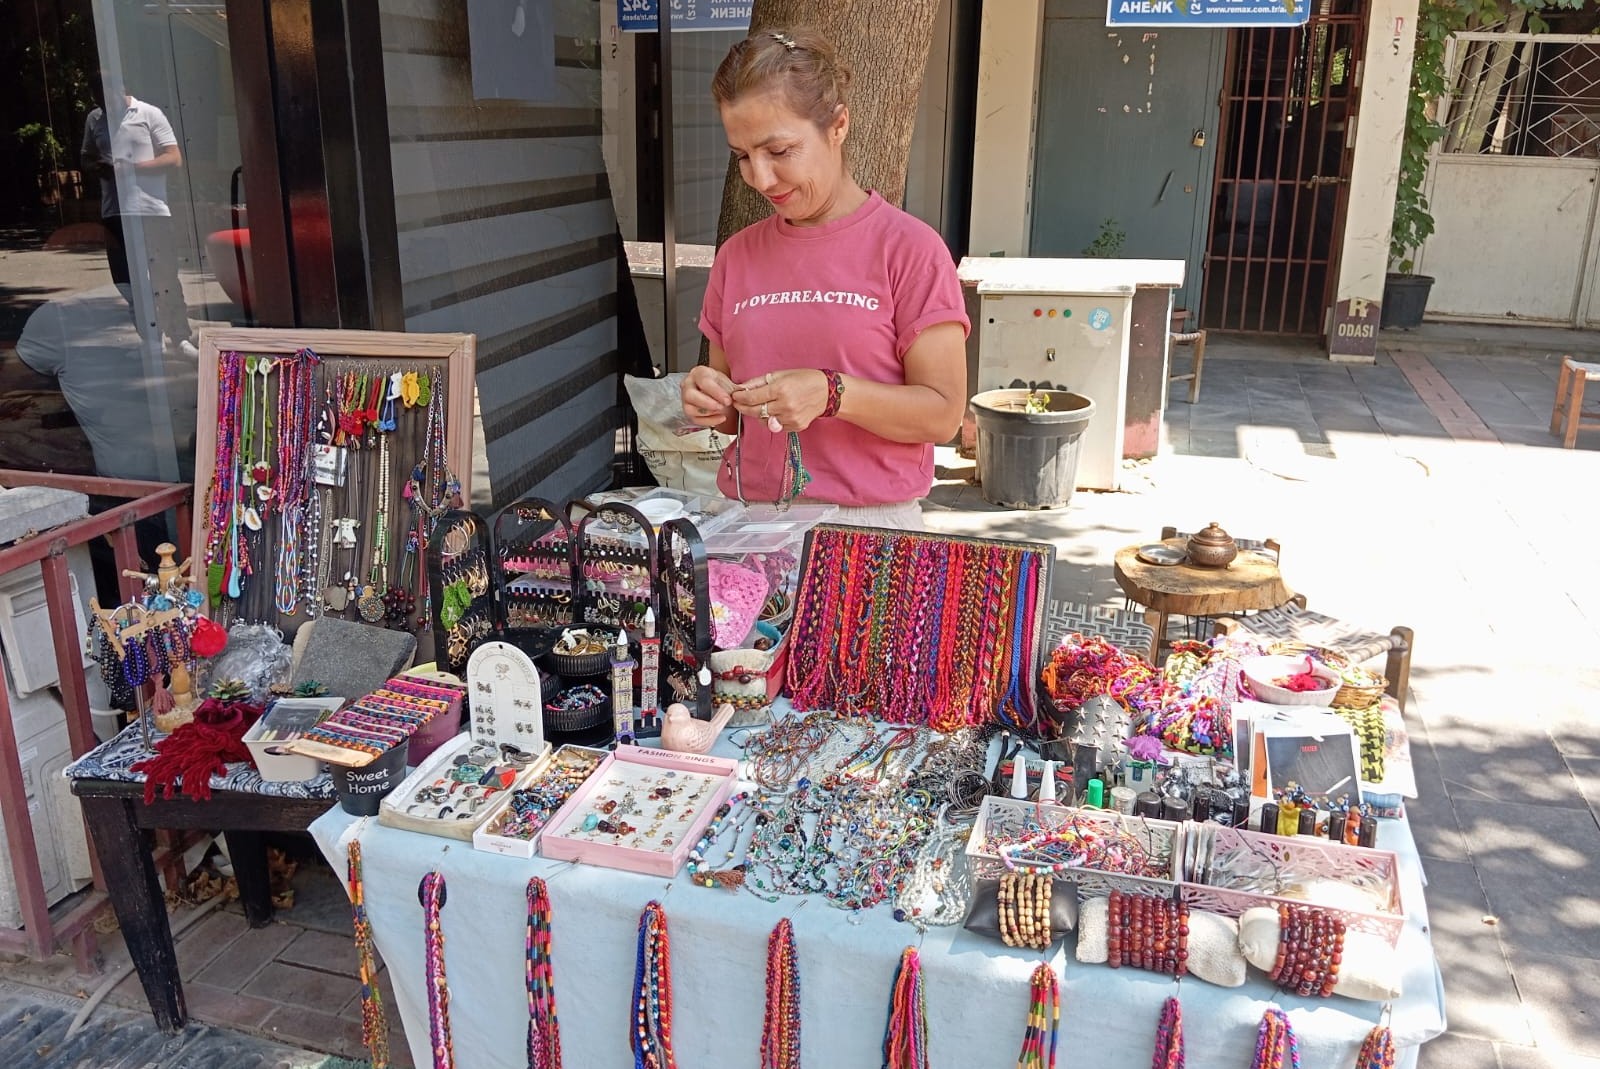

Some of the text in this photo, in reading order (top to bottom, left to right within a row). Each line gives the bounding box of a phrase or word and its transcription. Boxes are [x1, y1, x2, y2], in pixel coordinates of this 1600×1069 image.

[1119, 1, 1173, 14] AHENK
[1206, 5, 1304, 14] www.remax.com.tr/ank
[749, 290, 880, 311] OVERREACTING
[1338, 323, 1374, 338] ODASI
[638, 749, 715, 764] FASHION RINGS
[346, 768, 389, 782] Sweet
[349, 781, 390, 794] Home
